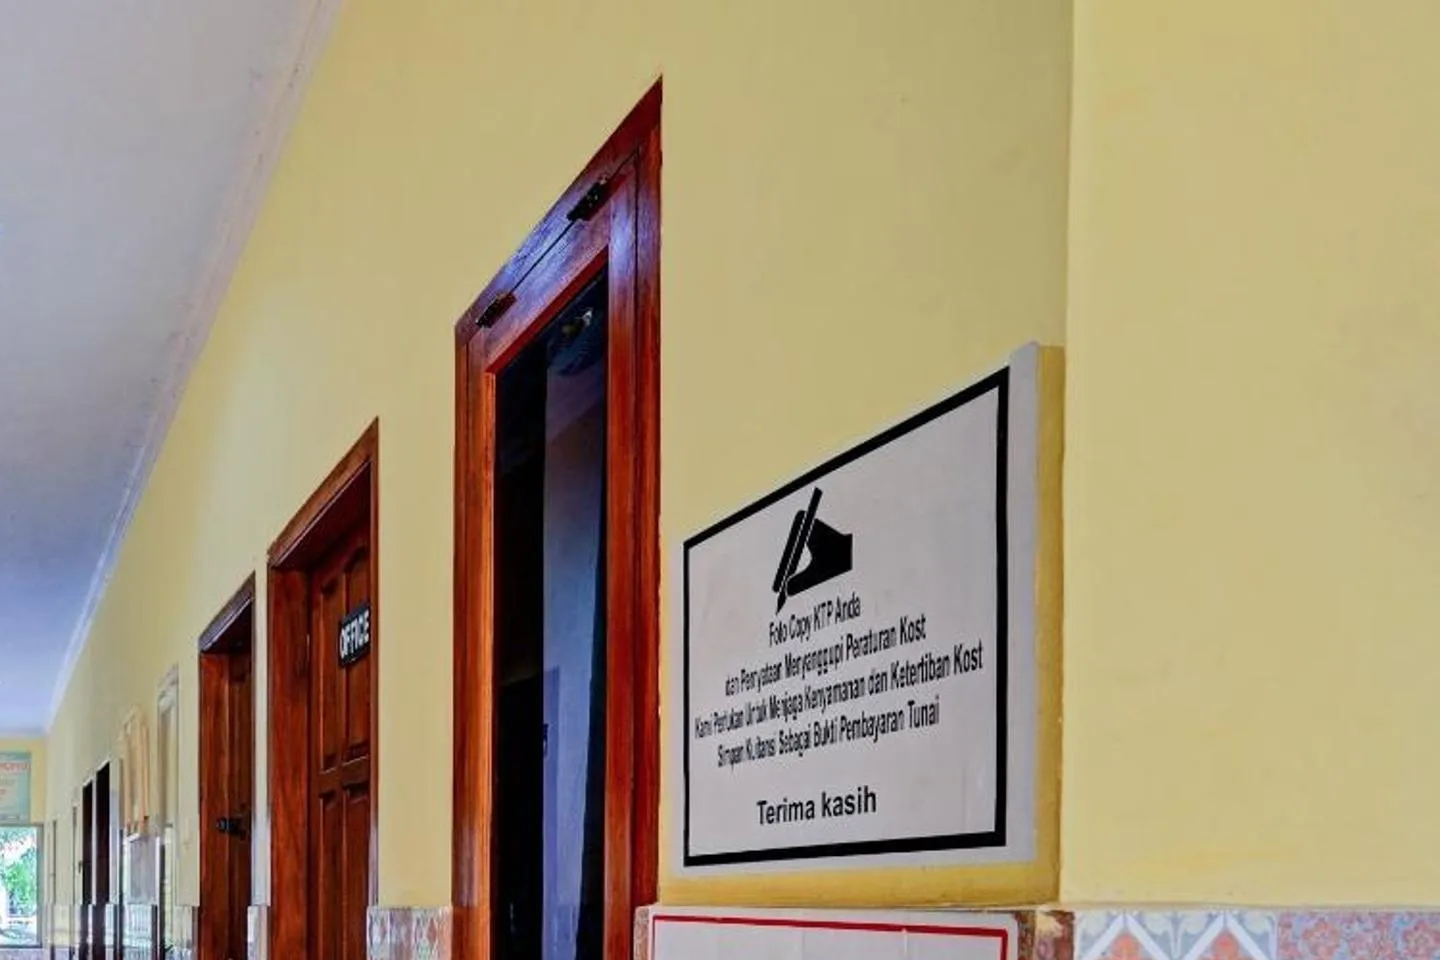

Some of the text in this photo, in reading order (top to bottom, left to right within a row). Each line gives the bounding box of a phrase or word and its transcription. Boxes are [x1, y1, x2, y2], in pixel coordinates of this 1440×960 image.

[340, 609, 369, 659] OFFICE
[769, 591, 861, 647] Foto Copy KTP Anda
[846, 626, 897, 660] Peraturan
[899, 612, 926, 645] Kost
[804, 676, 865, 714] Kenyamanan
[867, 667, 888, 696] dan
[890, 652, 950, 690] Ketertiban
[953, 638, 983, 675] Kost
[813, 716, 838, 748] Bukti
[840, 710, 904, 743] Pembayaran
[907, 694, 940, 729] Tunai
[756, 785, 877, 824] Terima kasih
